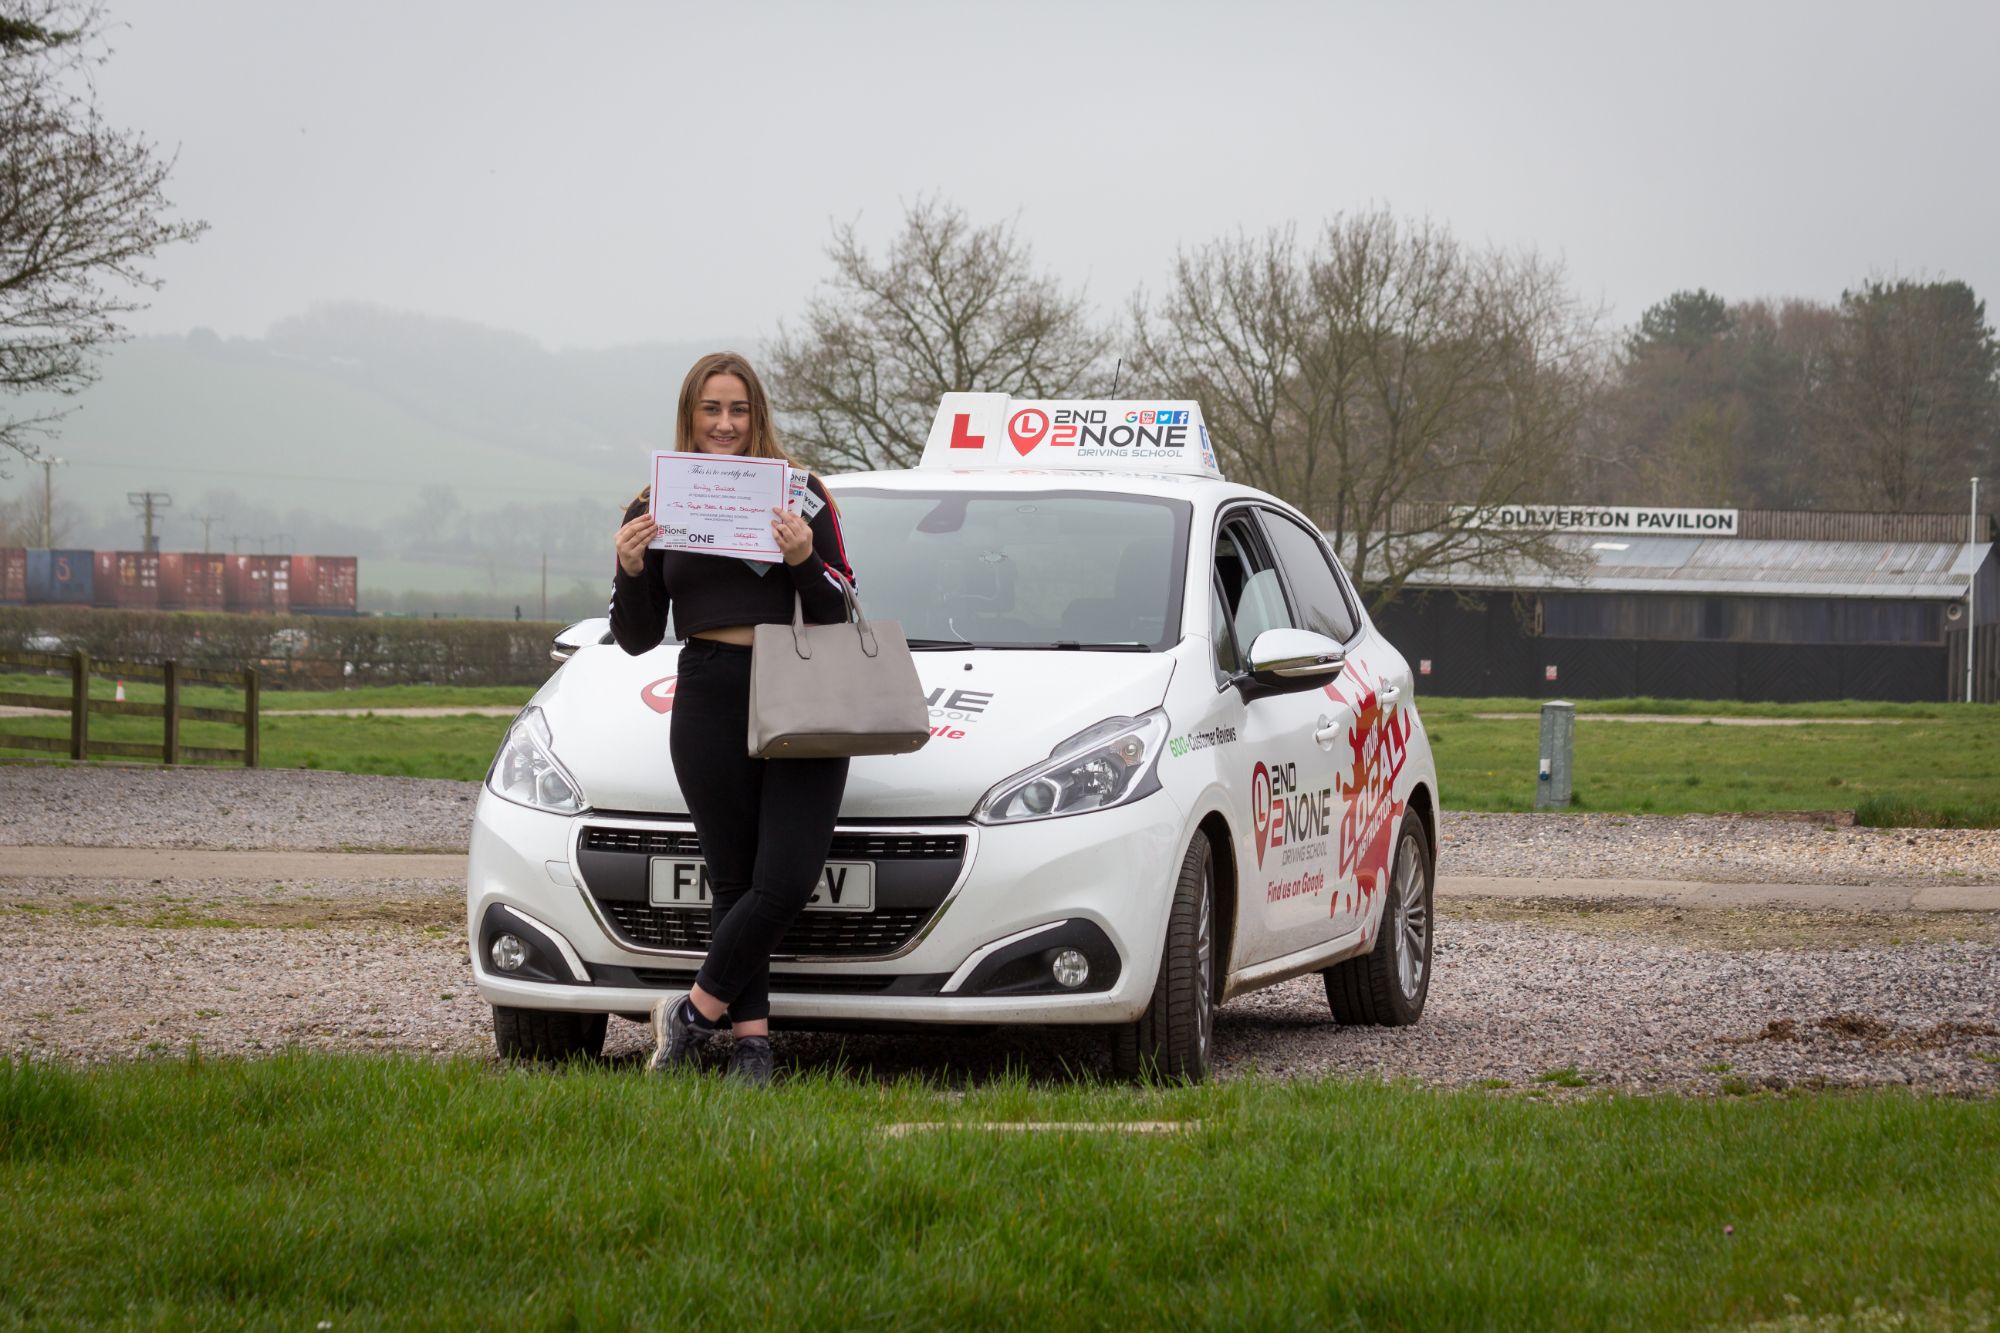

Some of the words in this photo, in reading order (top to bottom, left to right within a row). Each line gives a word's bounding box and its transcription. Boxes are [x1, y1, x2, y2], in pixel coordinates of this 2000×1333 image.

[1021, 416, 1037, 433] L
[1054, 410, 1107, 424] 2ND
[950, 413, 985, 449] L
[1050, 425, 1188, 447] 2NONE
[1077, 449, 1128, 457] DRIVING
[1131, 449, 1183, 457] SCHOOL
[688, 464, 705, 475] This
[720, 469, 741, 480] certify
[742, 469, 756, 478] that
[1500, 509, 1629, 528] DULVERTON
[1637, 512, 1733, 529] PAVILION
[928, 709, 977, 723] OOL
[1187, 731, 1216, 751] Customer
[1215, 725, 1237, 745] Reviews
[1362, 716, 1379, 774] YOUR
[1271, 762, 1296, 794] 2ND
[1343, 723, 1404, 867] LOCAL
[1281, 845, 1306, 866] DRIVING
[1306, 842, 1328, 860] SCHOOL
[1266, 878, 1283, 904] Find
[1282, 882, 1292, 899] us
[1292, 879, 1301, 897] on
[1301, 868, 1324, 897] Google
